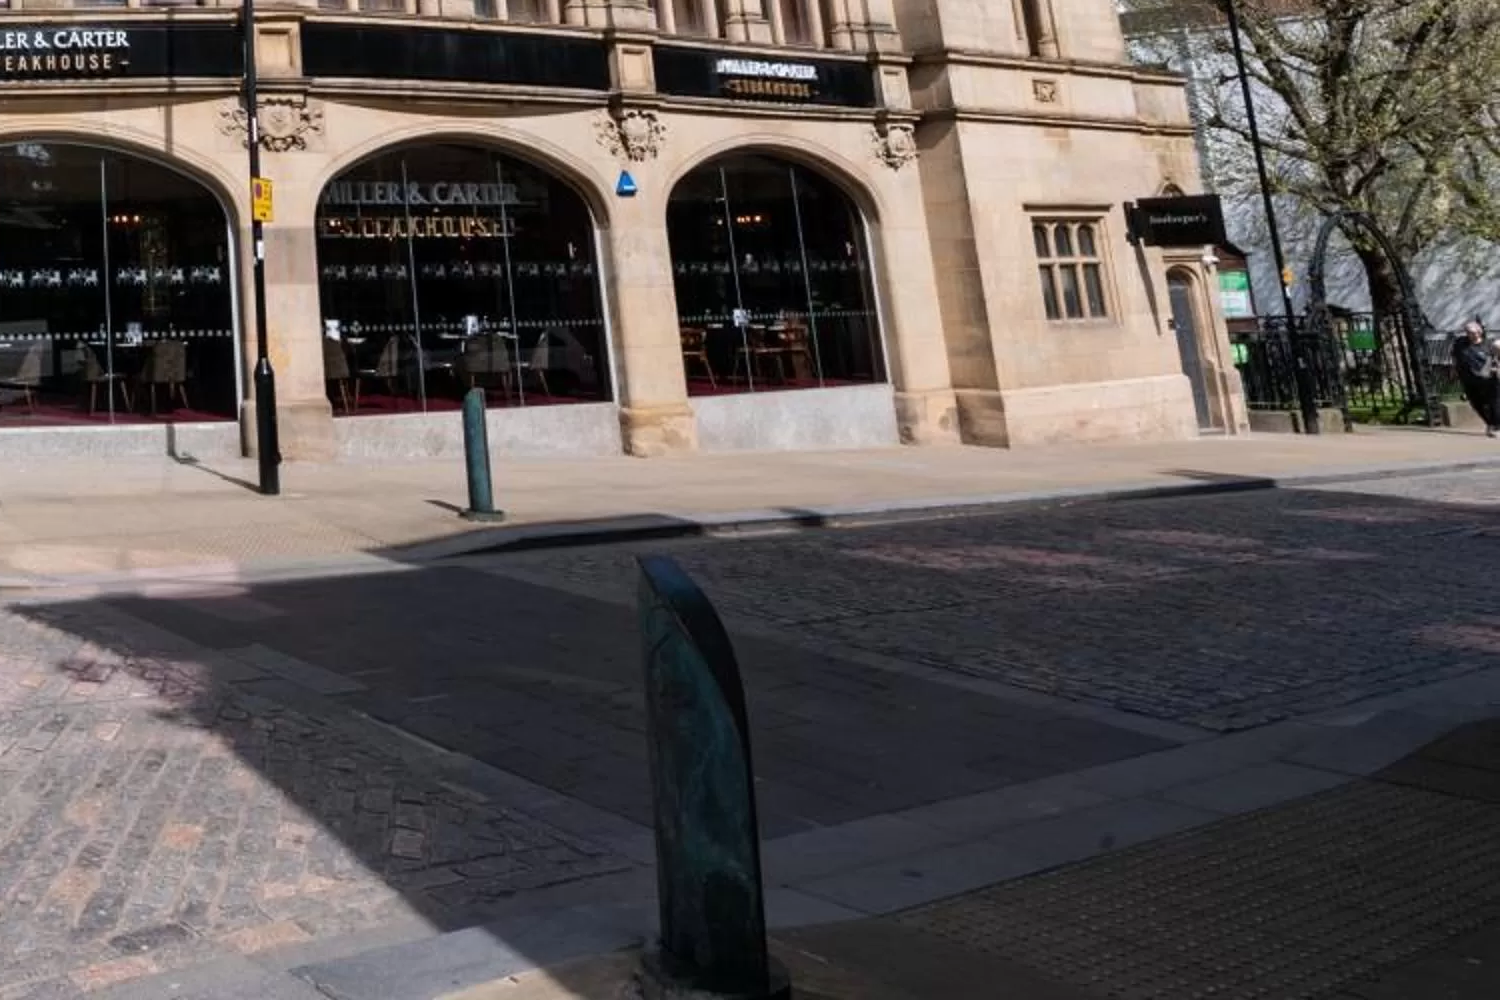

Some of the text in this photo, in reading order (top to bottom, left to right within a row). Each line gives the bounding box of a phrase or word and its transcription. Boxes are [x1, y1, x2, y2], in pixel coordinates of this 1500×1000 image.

[33, 31, 50, 49] &
[53, 31, 130, 48] CARTER
[326, 180, 404, 204] MILLER
[431, 183, 521, 204] CARTER
